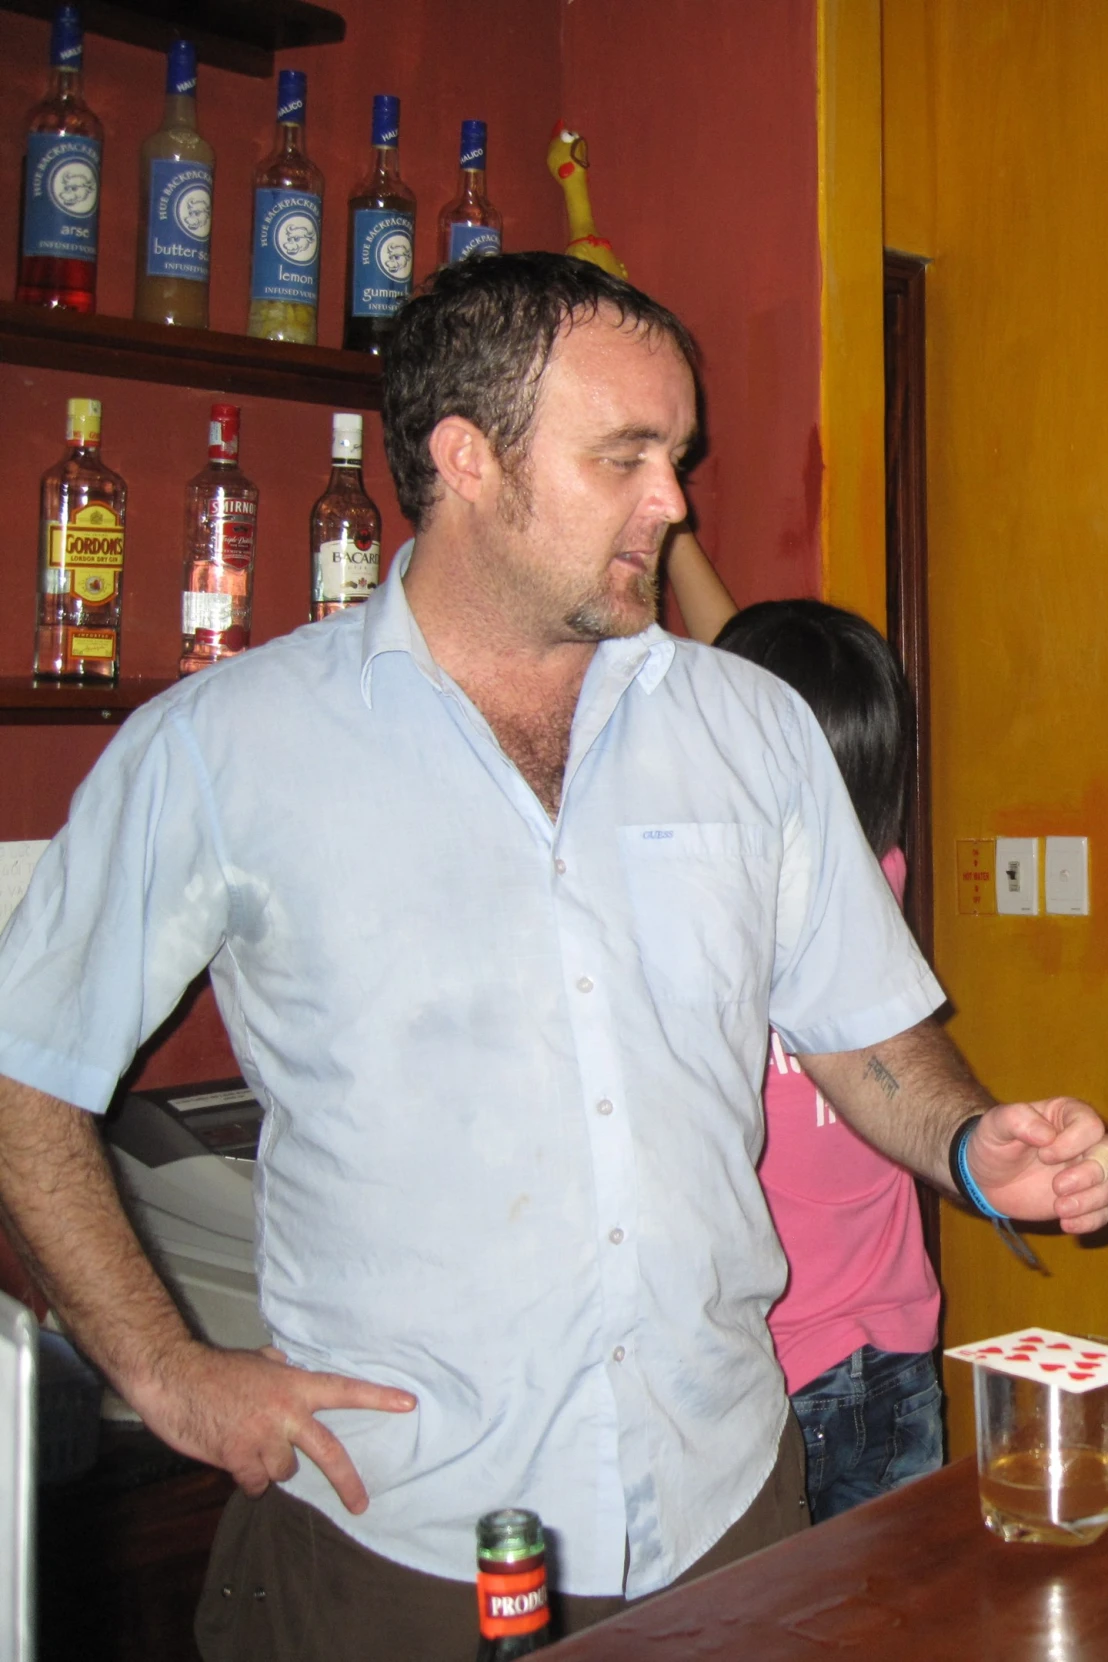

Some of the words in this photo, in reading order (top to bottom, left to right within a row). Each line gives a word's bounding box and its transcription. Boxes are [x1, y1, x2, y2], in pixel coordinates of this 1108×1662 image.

[60, 224, 90, 237] arse
[278, 266, 313, 285] lemon
[264, 286, 298, 297] INFUSED
[66, 534, 123, 556] GORDON'S
[642, 830, 674, 840] GUESS
